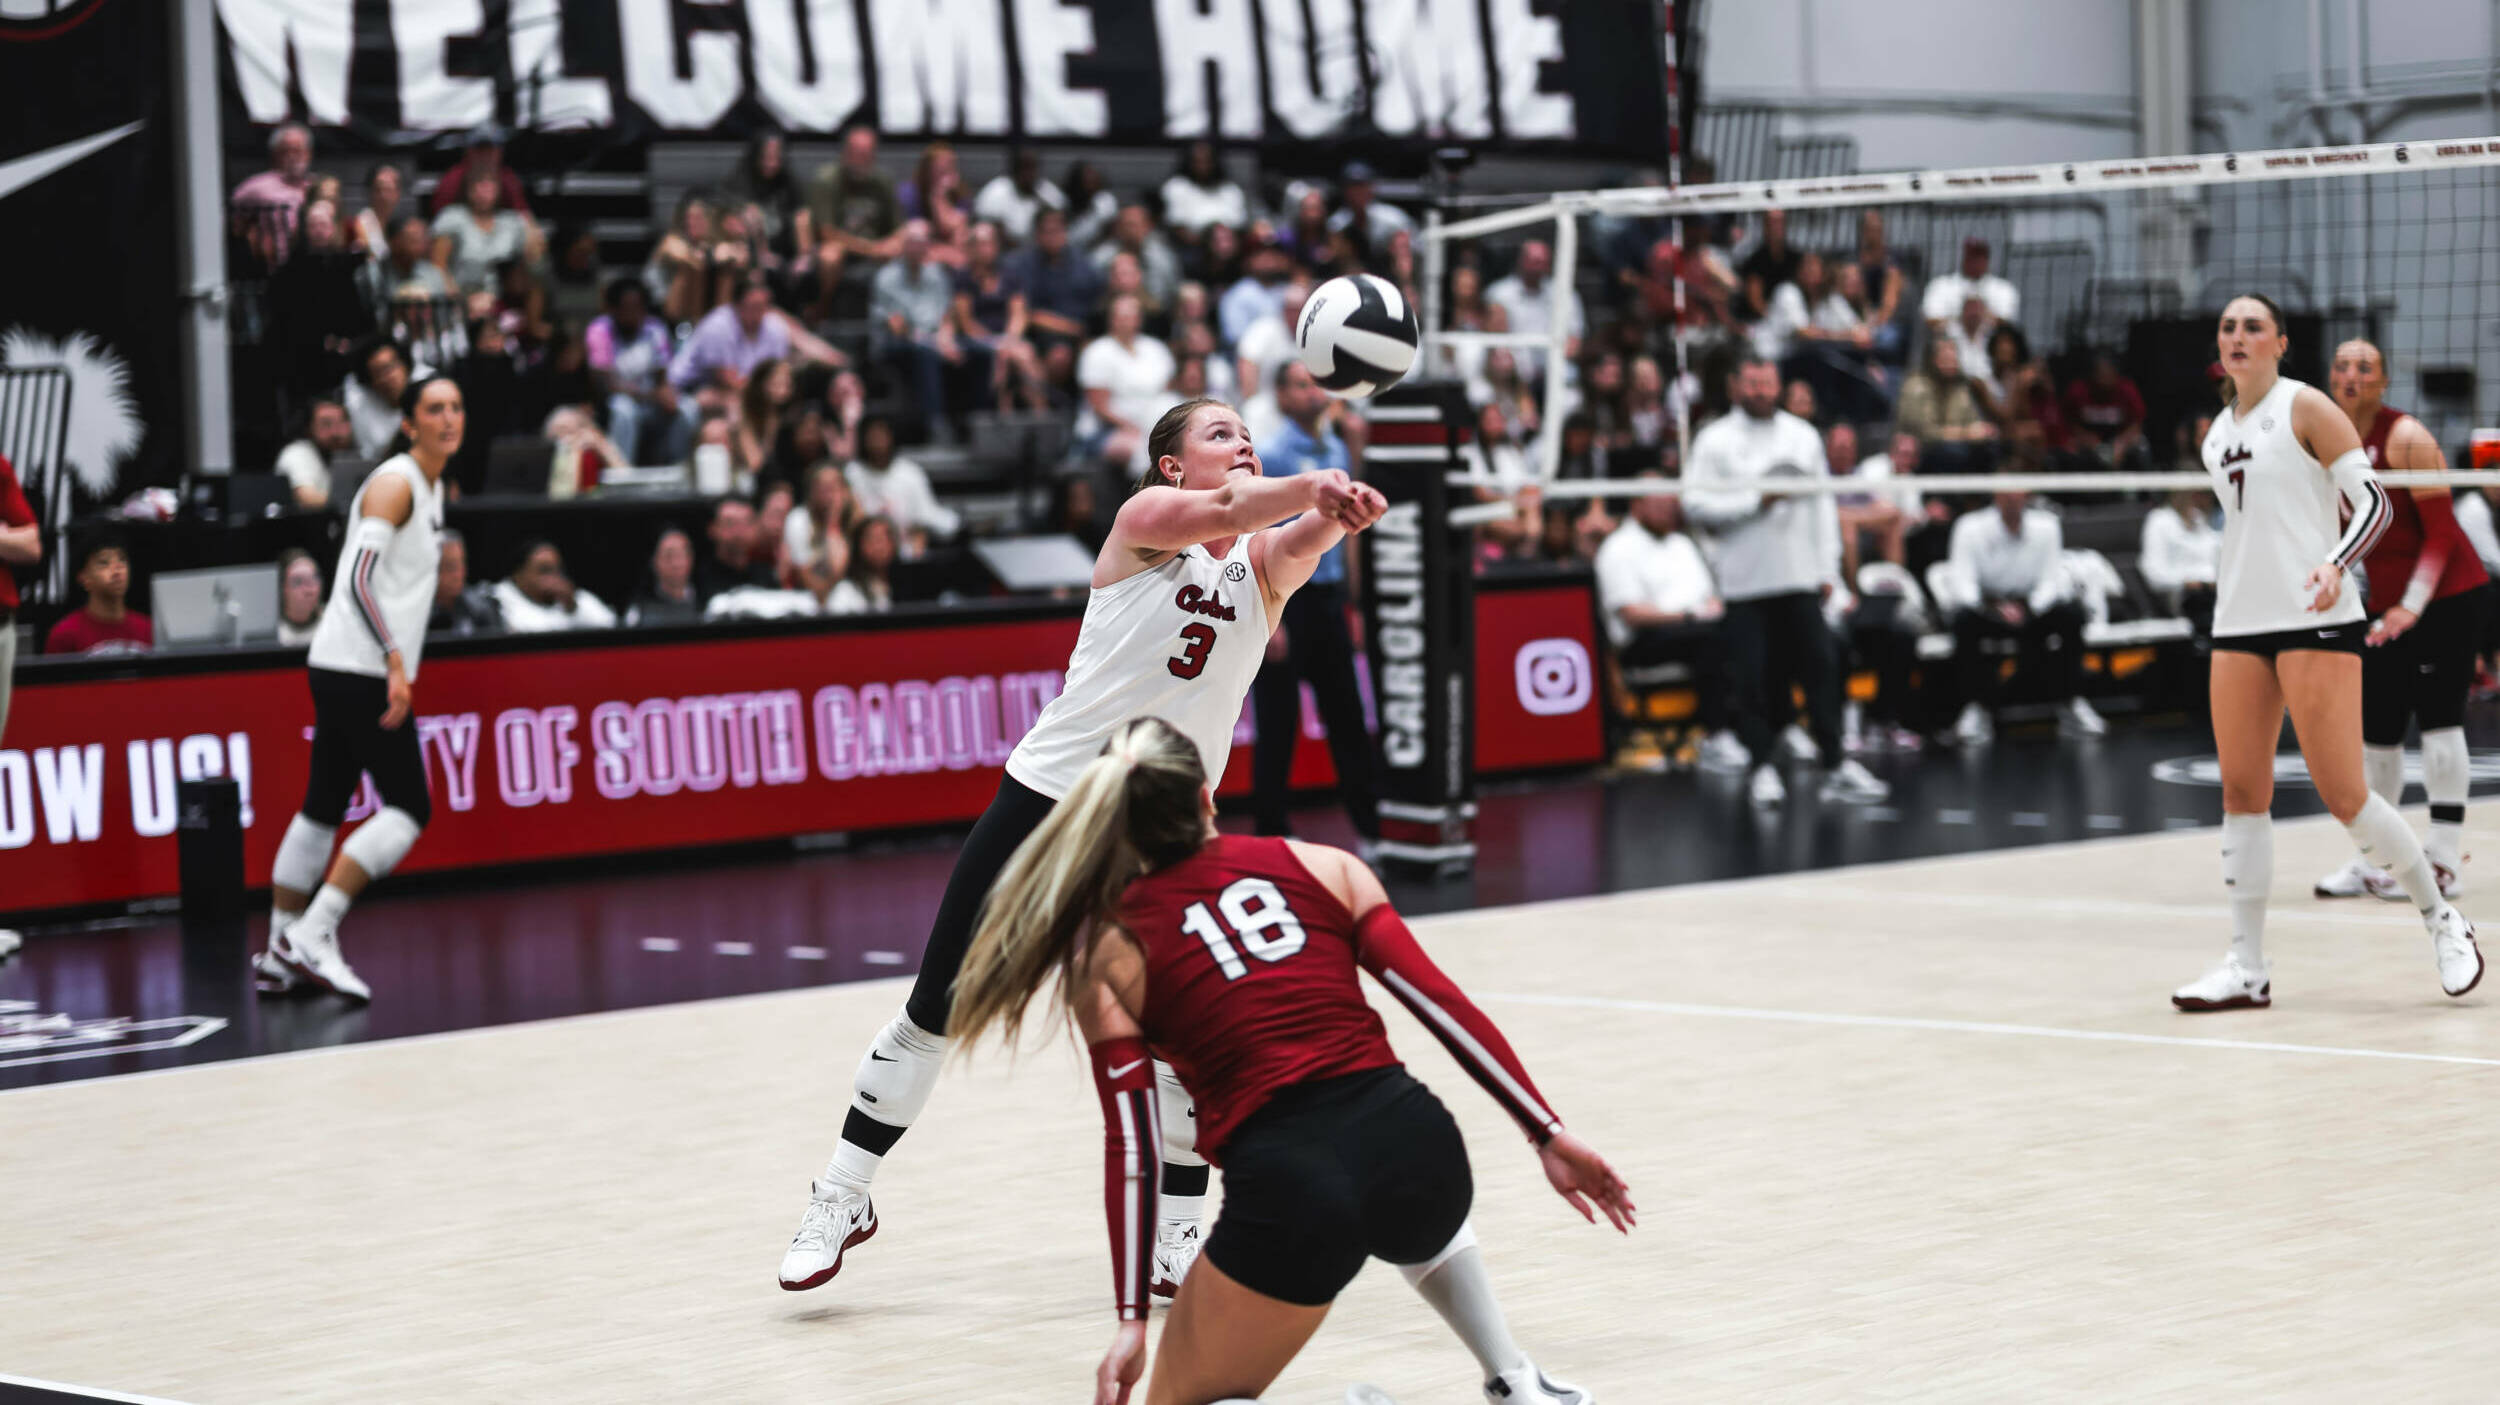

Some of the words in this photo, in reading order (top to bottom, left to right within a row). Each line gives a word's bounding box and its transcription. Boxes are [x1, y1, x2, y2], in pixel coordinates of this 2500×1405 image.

[1154, 0, 1576, 140] HOME
[2228, 468, 2245, 512] 7
[1226, 563, 1246, 581] SEC
[1167, 621, 1218, 681] 3
[1372, 502, 1426, 768] CAROLINA
[495, 706, 581, 807] OF
[590, 691, 808, 799] SOUTH
[813, 671, 1063, 781] CAROLI
[1180, 877, 1308, 982] 18
